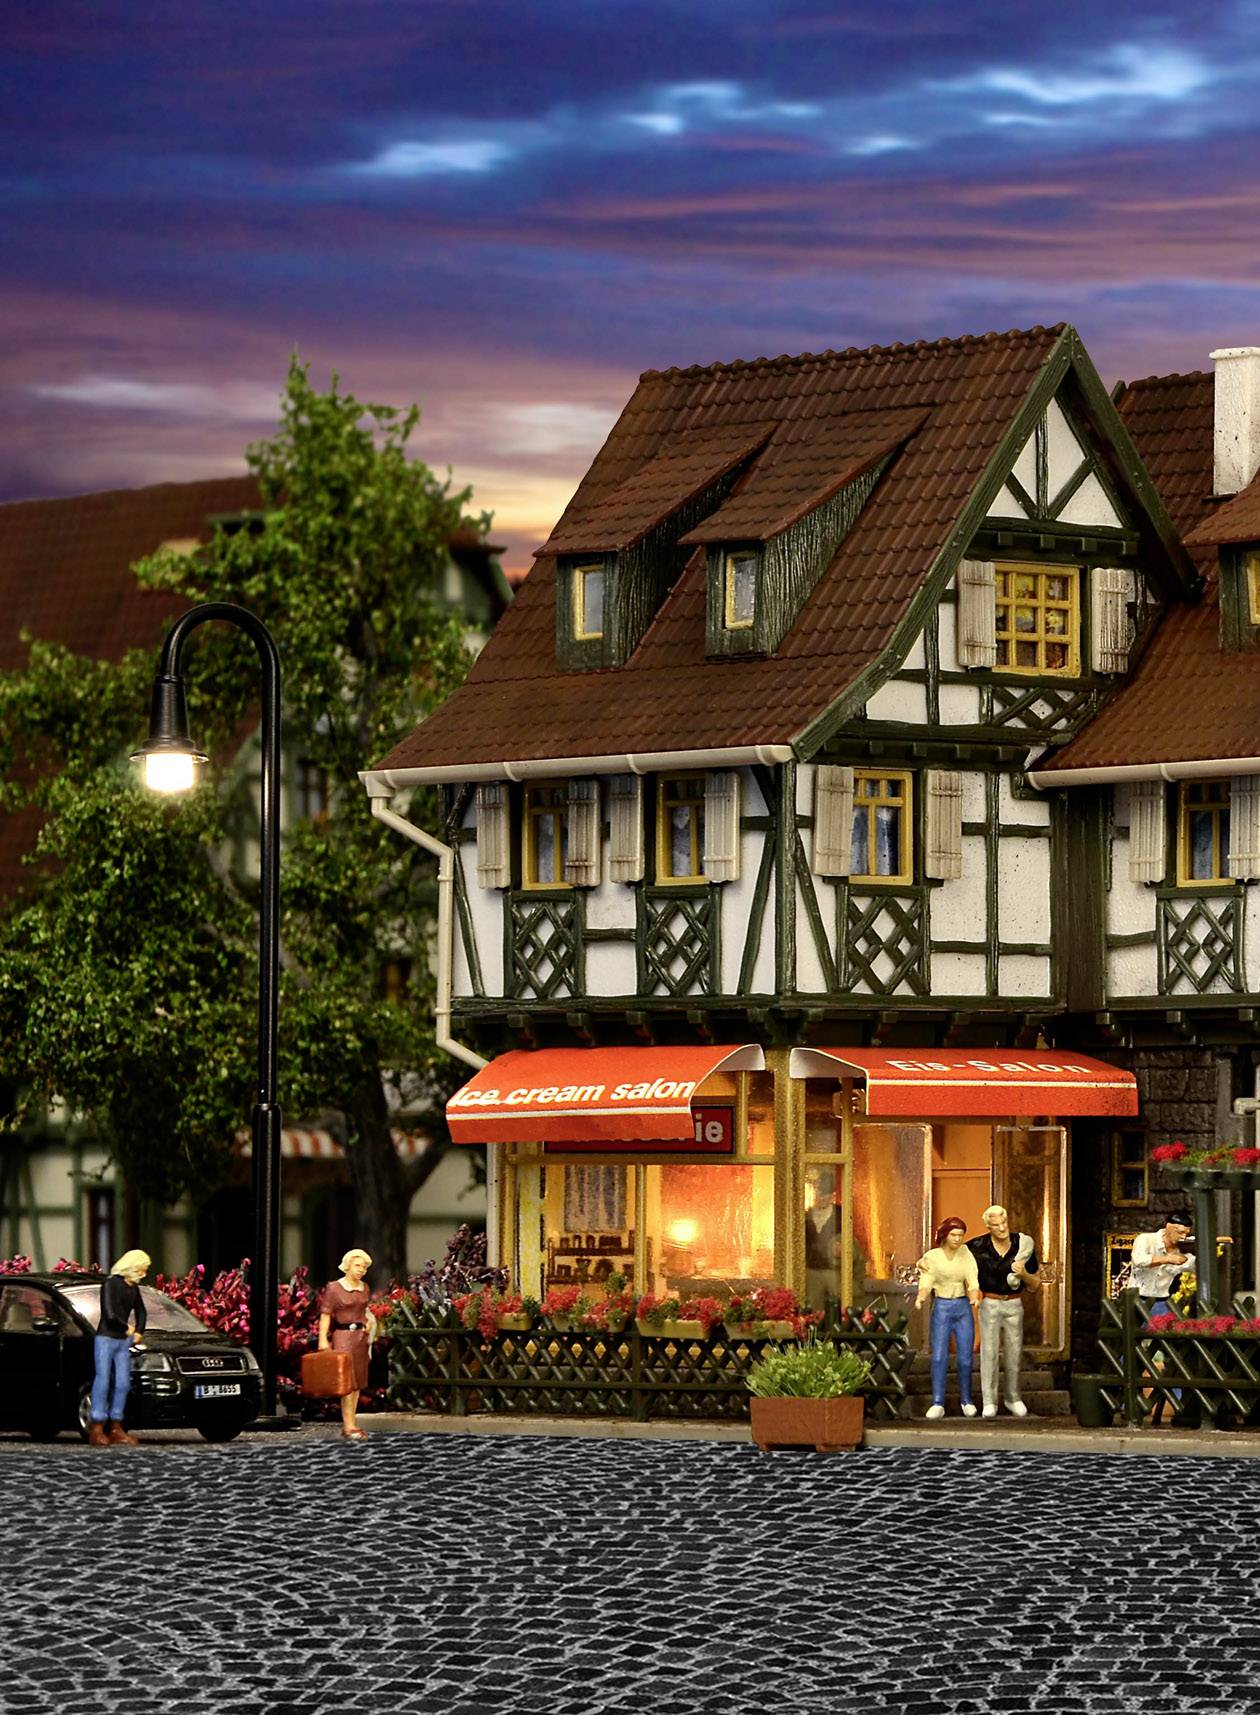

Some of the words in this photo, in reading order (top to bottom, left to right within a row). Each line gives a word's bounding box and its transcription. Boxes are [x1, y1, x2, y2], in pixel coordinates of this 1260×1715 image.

[886, 1060, 1092, 1073] Eis-Salon
[447, 1087, 500, 1107] Ice
[503, 1084, 605, 1105] cream
[610, 1077, 696, 1100] salon
